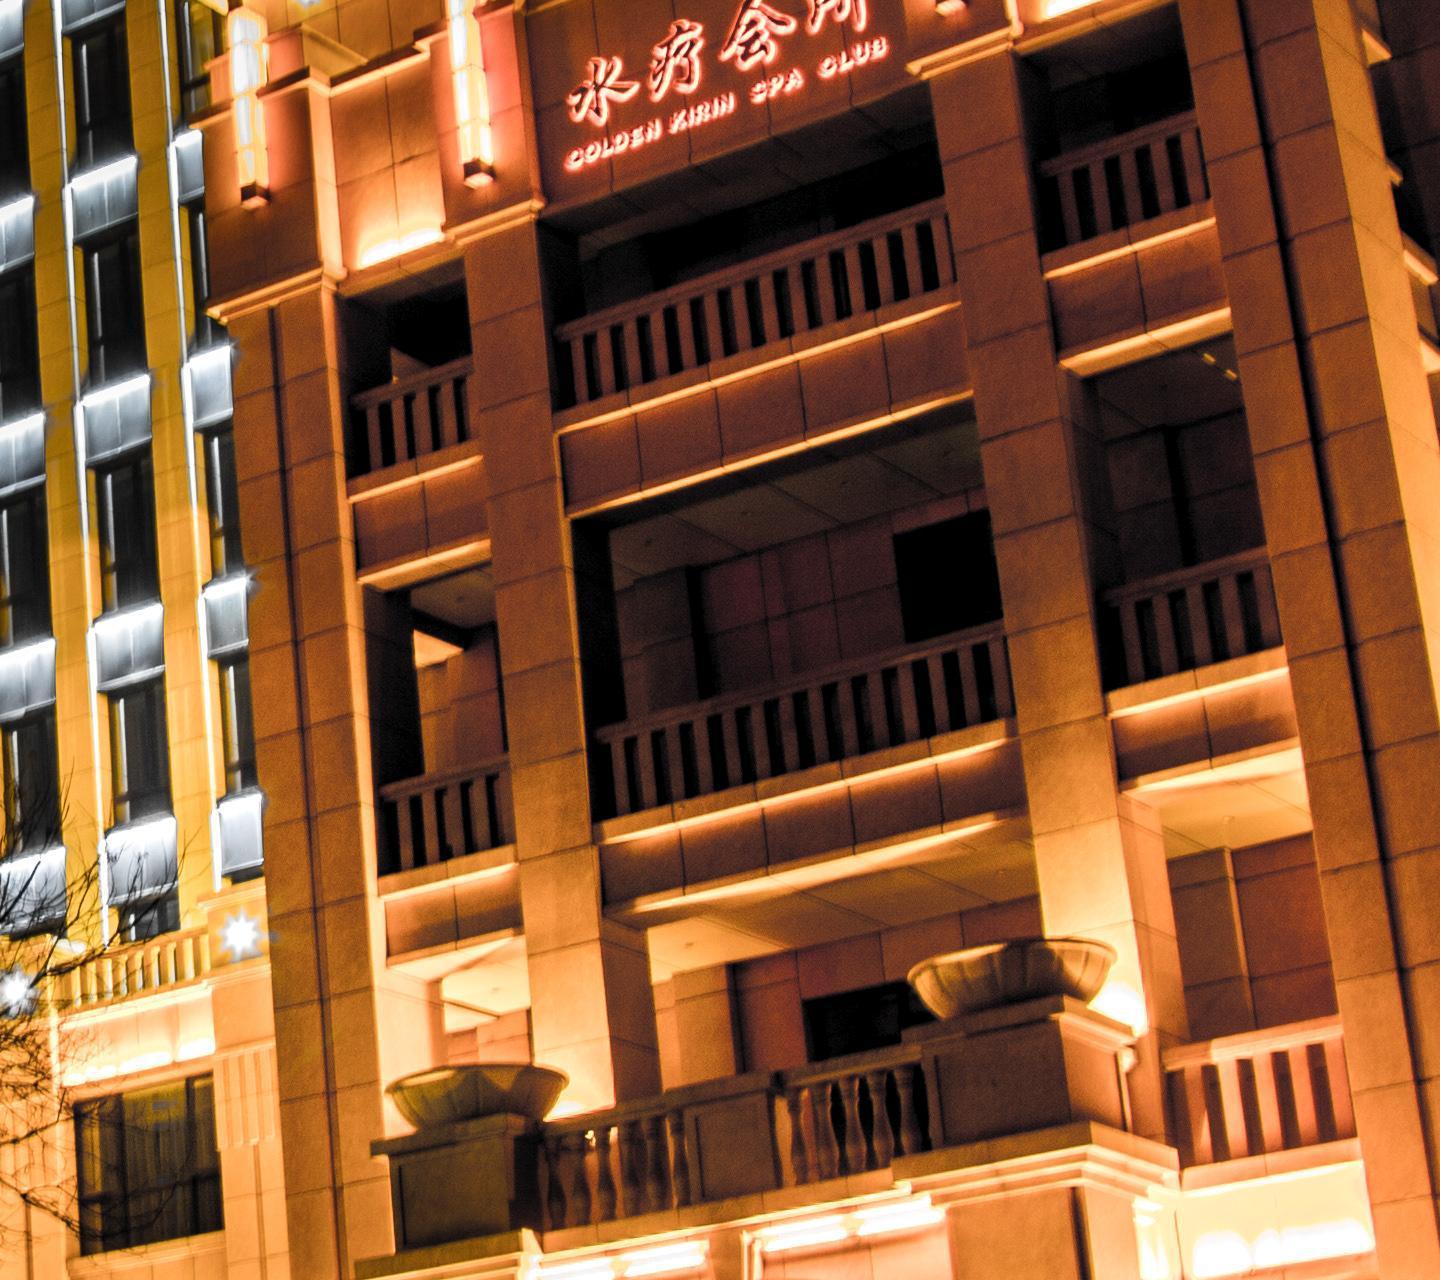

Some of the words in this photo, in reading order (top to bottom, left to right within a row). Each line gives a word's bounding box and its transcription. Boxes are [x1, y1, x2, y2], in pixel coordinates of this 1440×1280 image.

[564, 119, 662, 173] GOLDEN
[669, 92, 736, 135] KIRIN
[749, 67, 805, 105] SPA
[817, 36, 890, 79] CLUB
